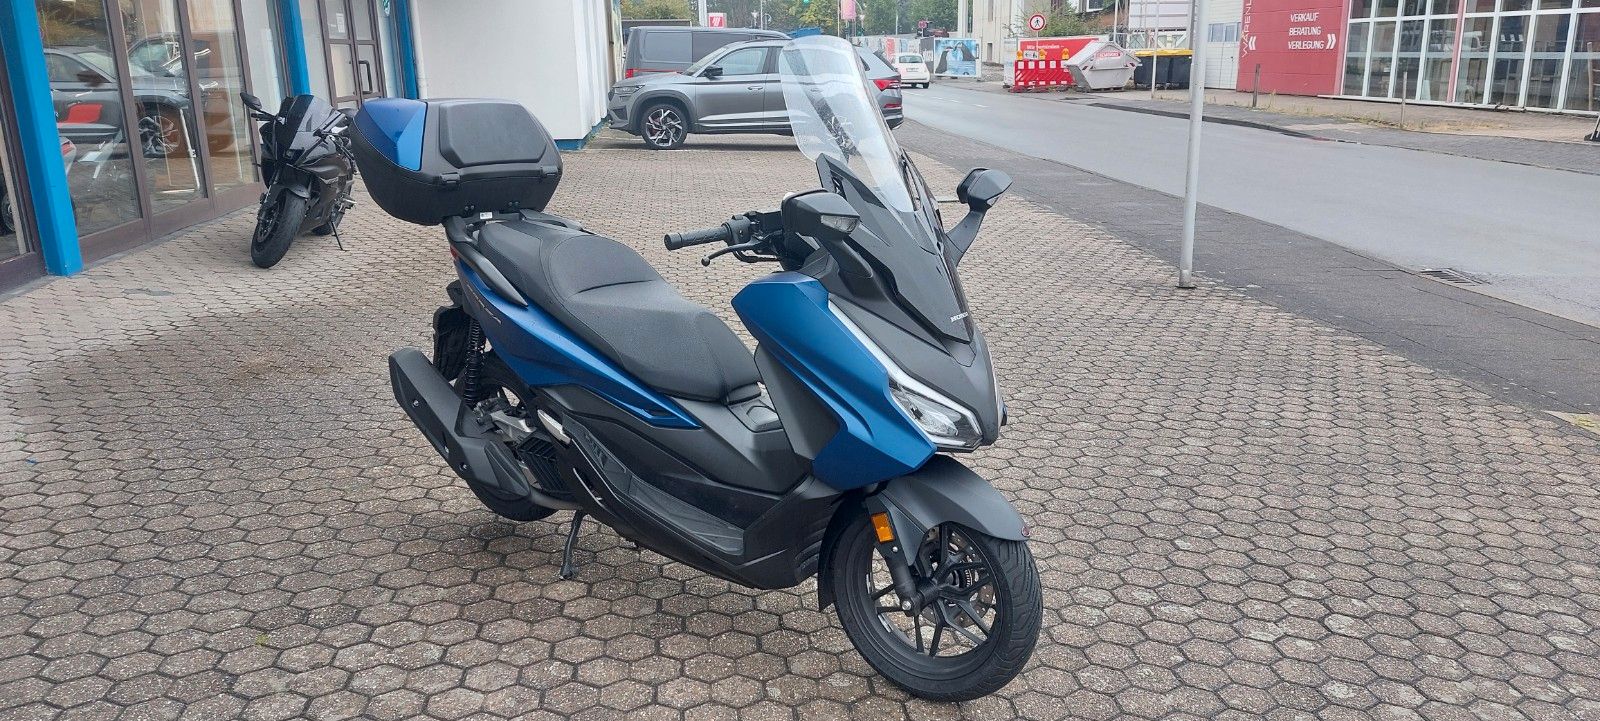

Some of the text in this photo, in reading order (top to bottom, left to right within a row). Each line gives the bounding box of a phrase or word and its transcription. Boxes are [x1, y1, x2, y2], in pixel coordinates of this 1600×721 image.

[1290, 12, 1319, 22] VERKAUF
[1288, 26, 1322, 36] BERATUNG
[1287, 40, 1325, 50] VERLEGUNG
